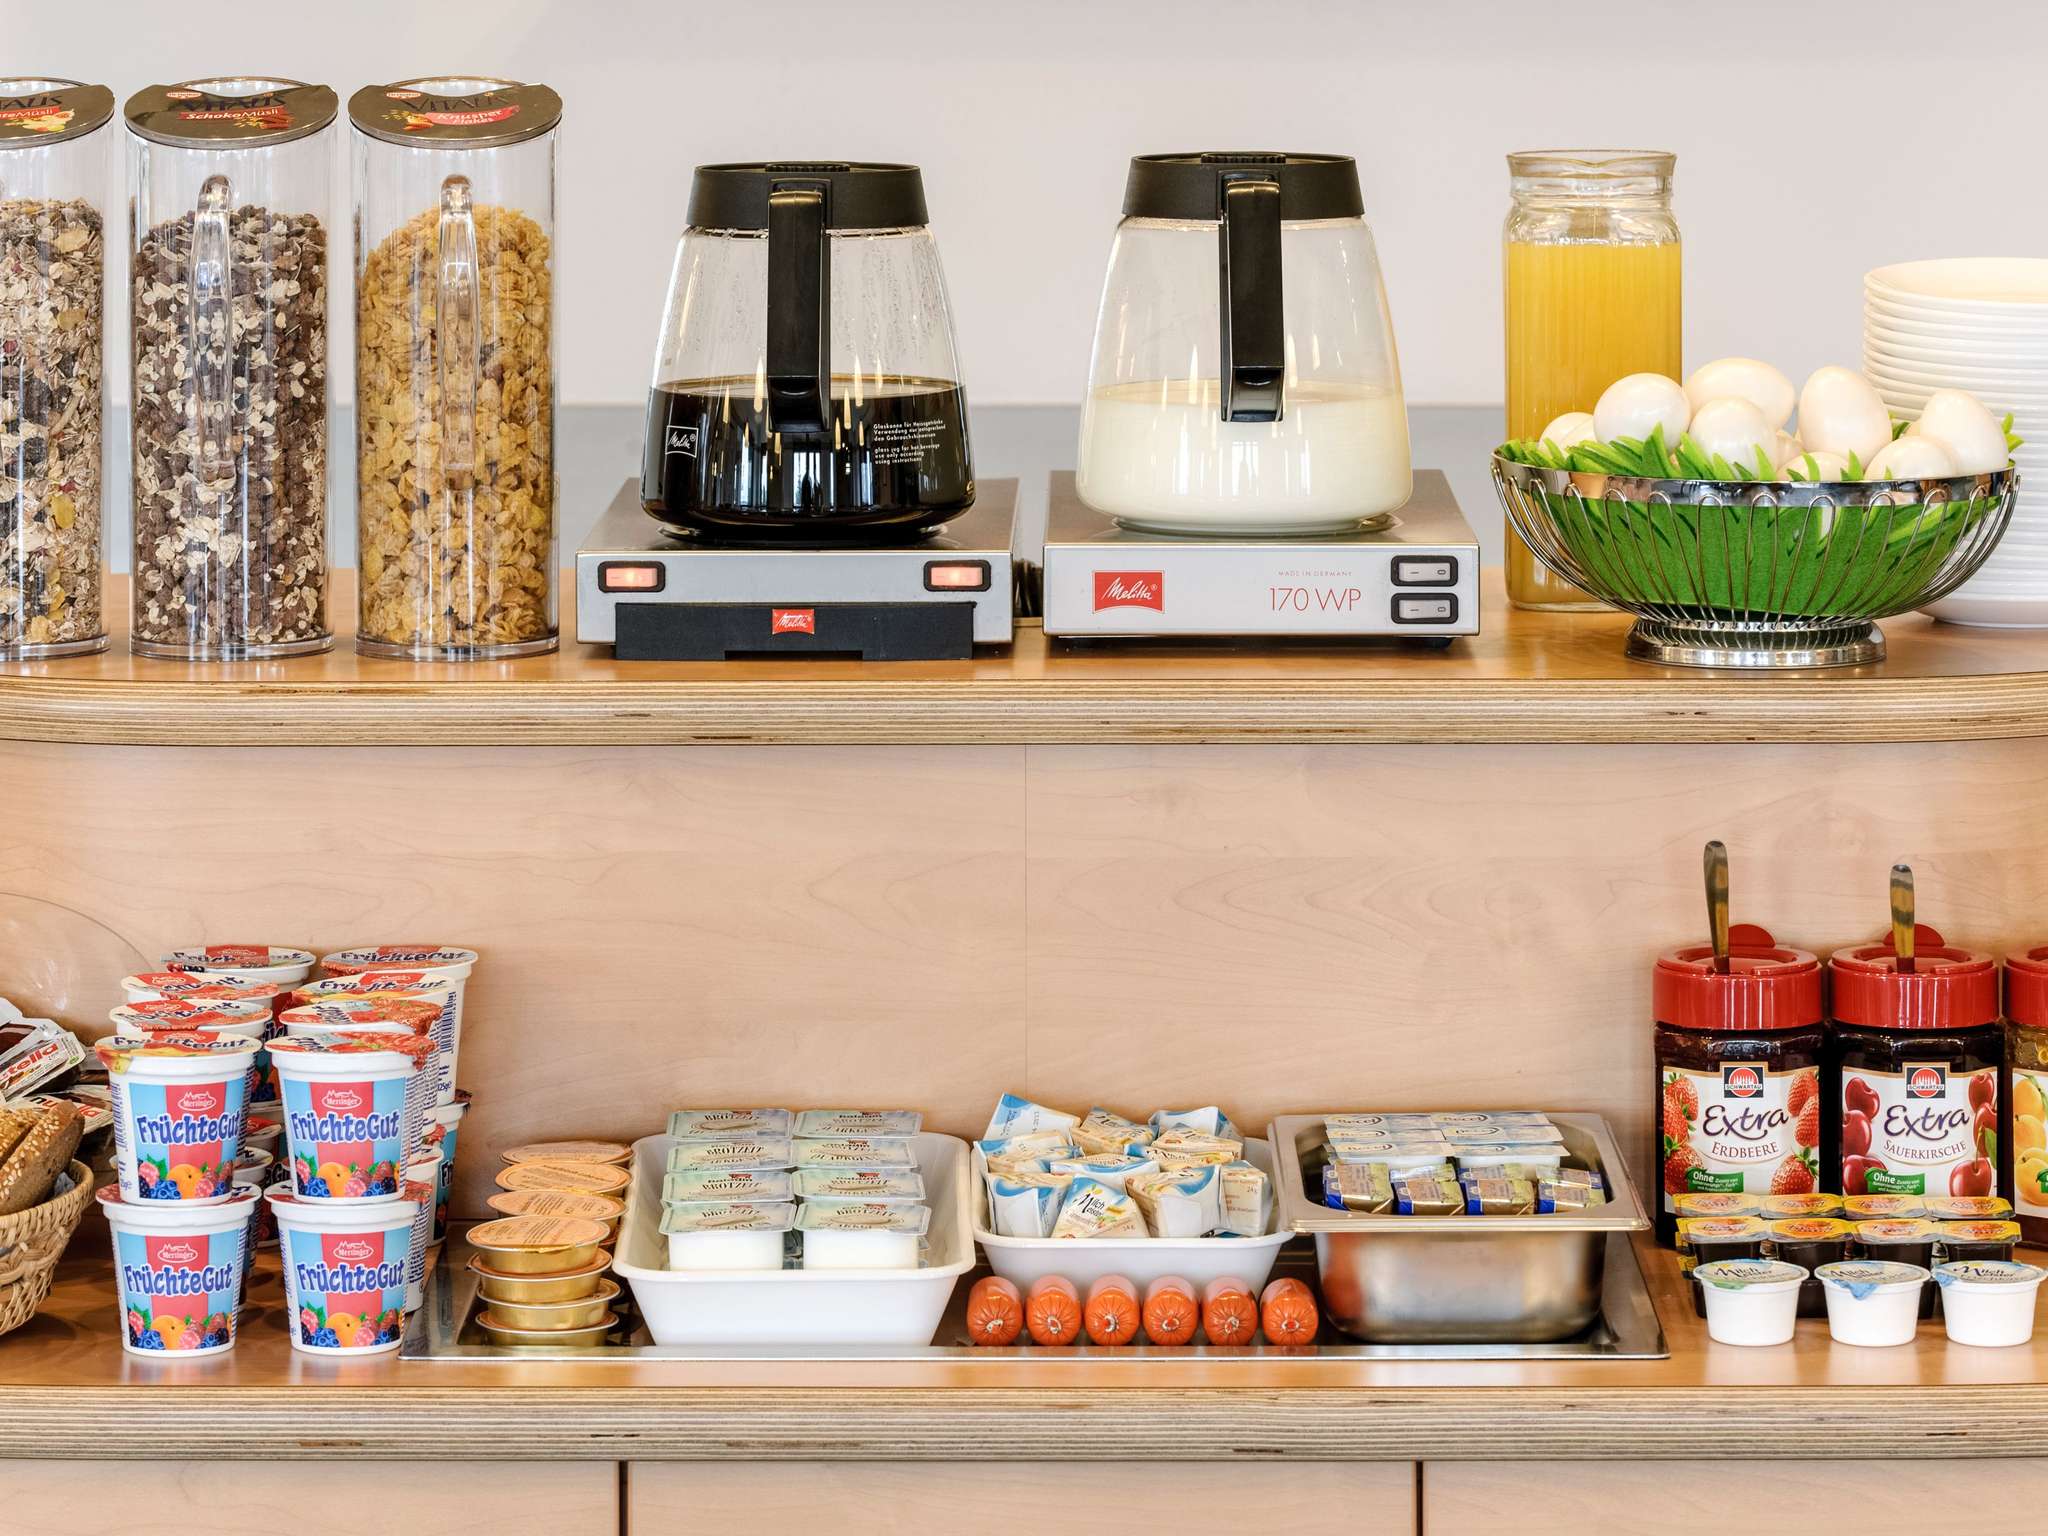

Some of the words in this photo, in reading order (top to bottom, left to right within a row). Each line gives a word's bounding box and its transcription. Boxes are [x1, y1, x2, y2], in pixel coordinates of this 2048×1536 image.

[1101, 576, 1153, 601] Melitta
[1269, 587, 1310, 612] 170
[1314, 587, 1362, 612] WP
[136, 1110, 241, 1145] FrüchteGut
[291, 1110, 400, 1143] FrüchteGut
[1703, 1104, 1789, 1140] Extra
[1884, 1104, 1970, 1141] Extra
[1712, 1141, 1779, 1158] ERDBEERE
[1884, 1140, 1967, 1159] SAUERKIRSCHE
[1693, 1171, 1714, 1183] Ohne
[1873, 1172, 1896, 1184] Ohne
[124, 1263, 233, 1296] FrüchteGut
[296, 1259, 405, 1293] FrüchteGut
